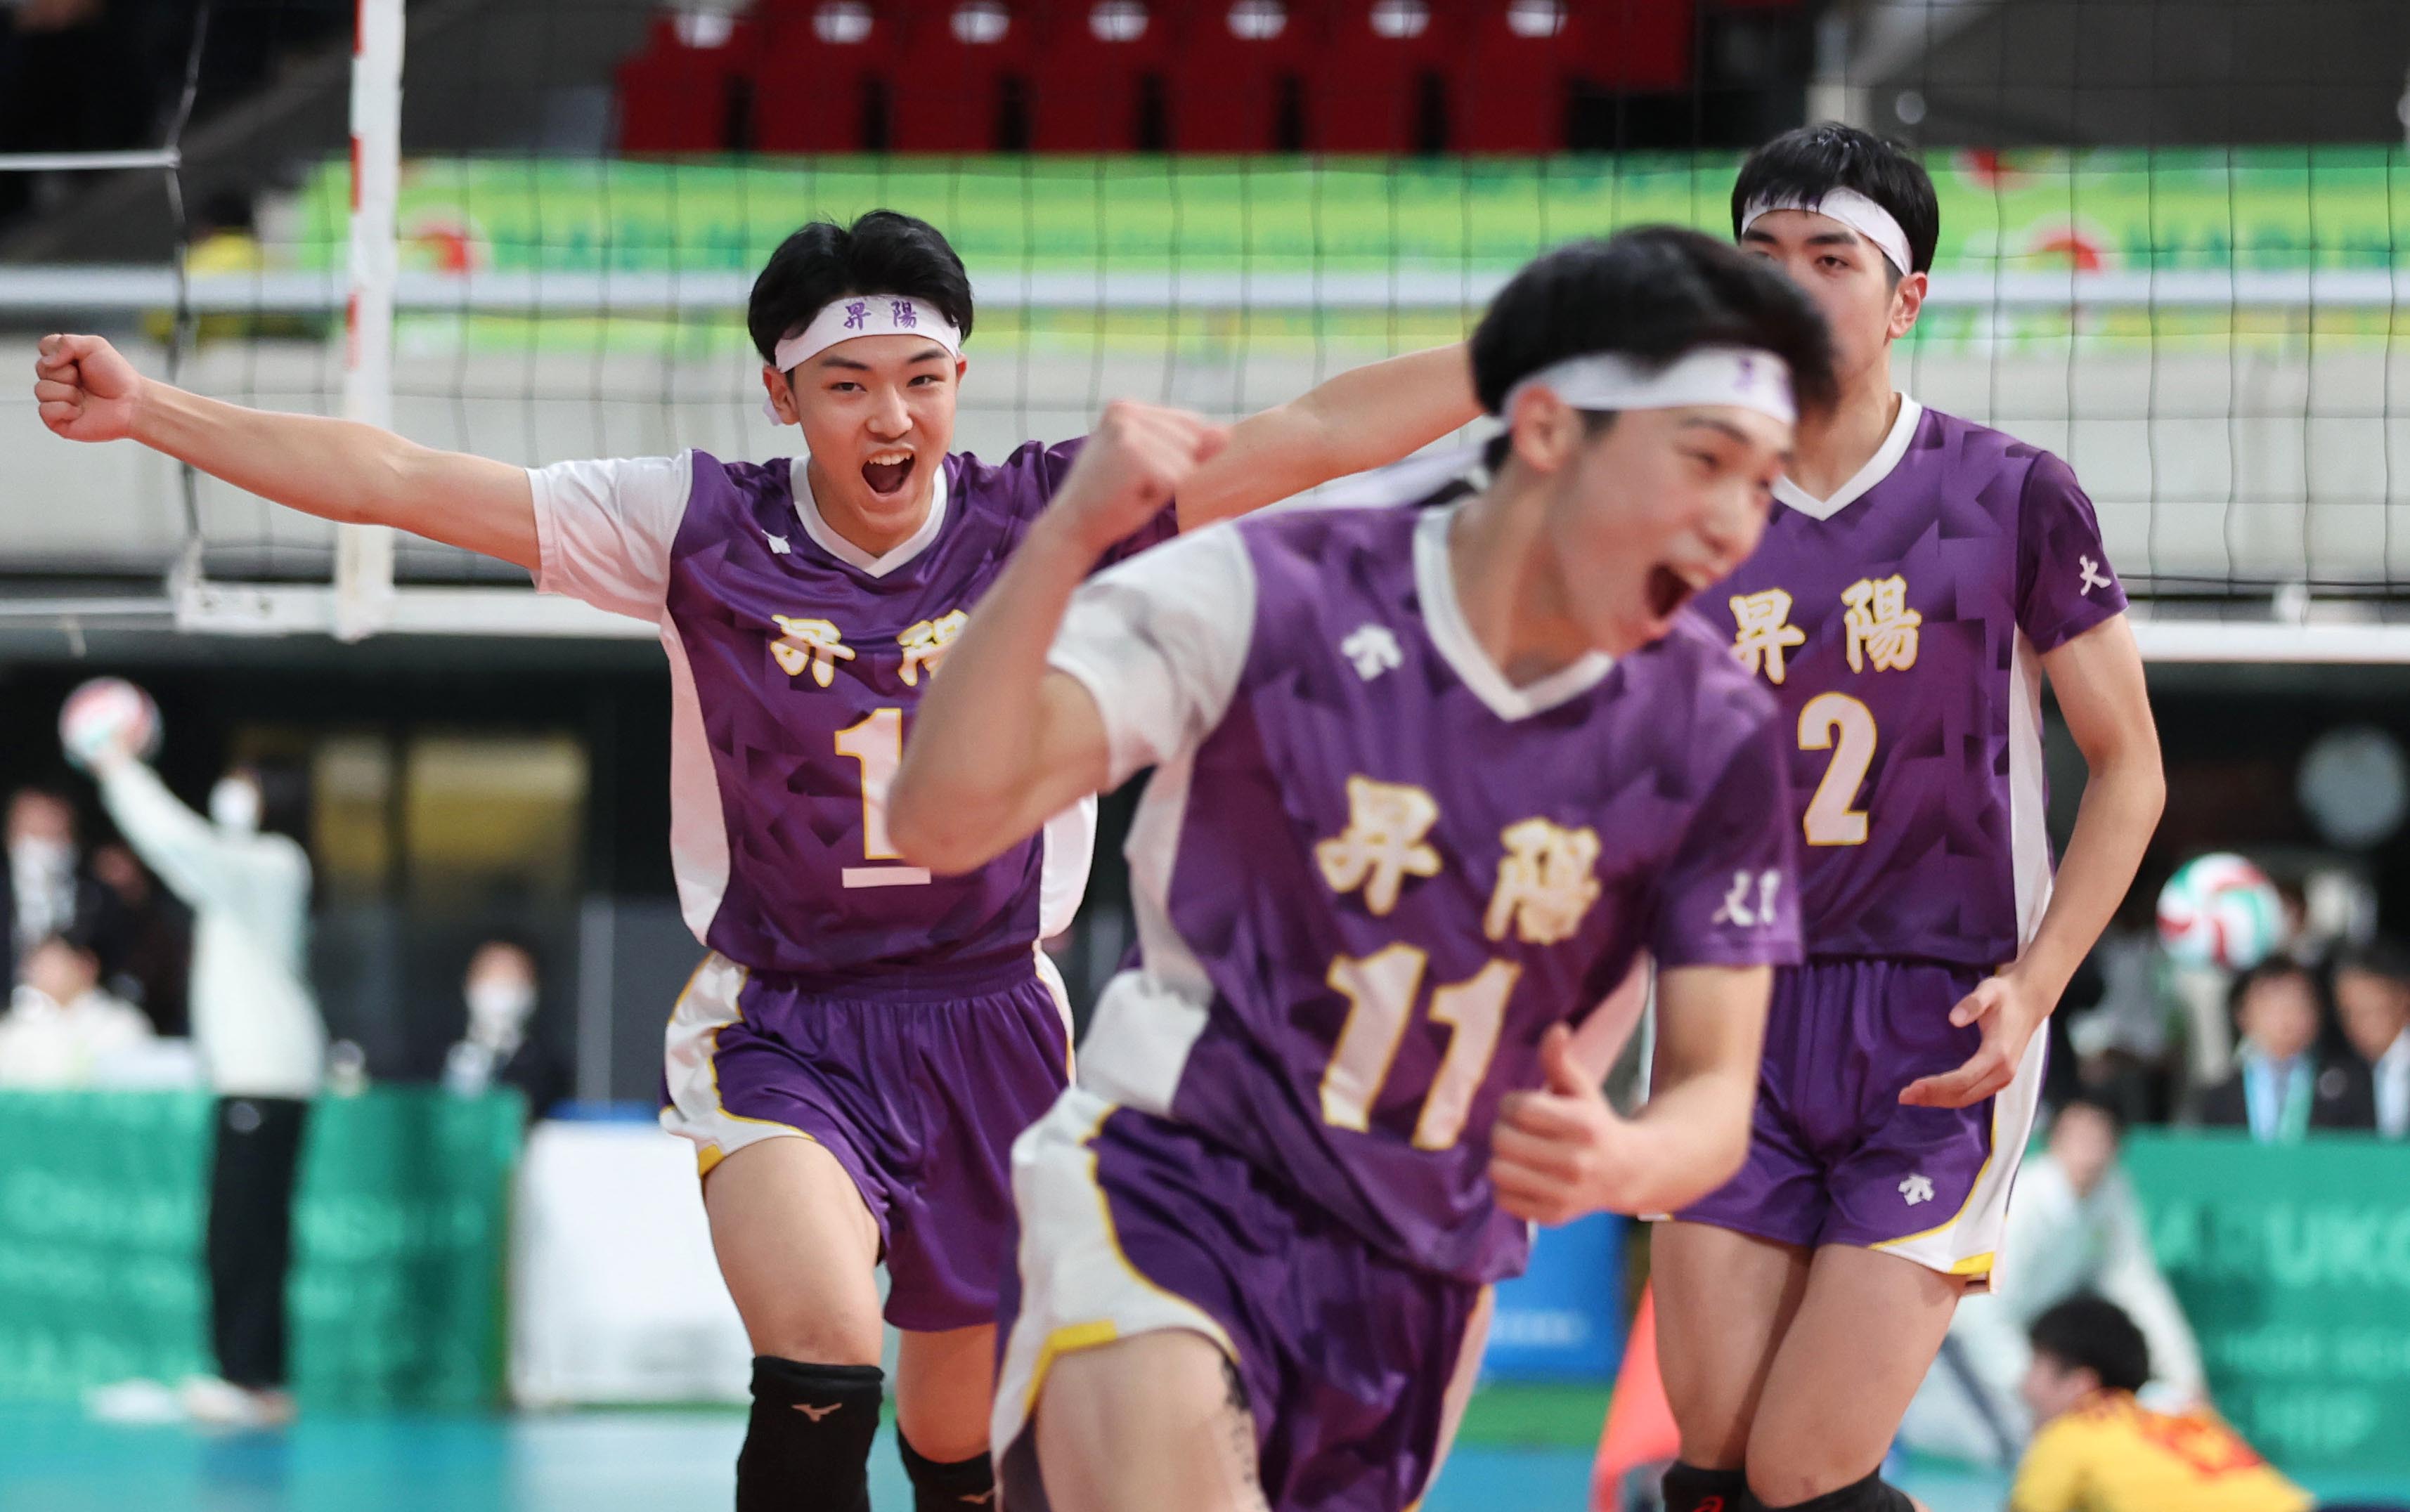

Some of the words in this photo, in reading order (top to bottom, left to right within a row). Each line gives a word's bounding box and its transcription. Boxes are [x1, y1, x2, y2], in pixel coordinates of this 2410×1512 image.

[1728, 574, 1922, 685] 昇陽
[834, 707, 907, 860] 1
[1797, 691, 1878, 846] 2
[1326, 940, 1524, 1151] 11
